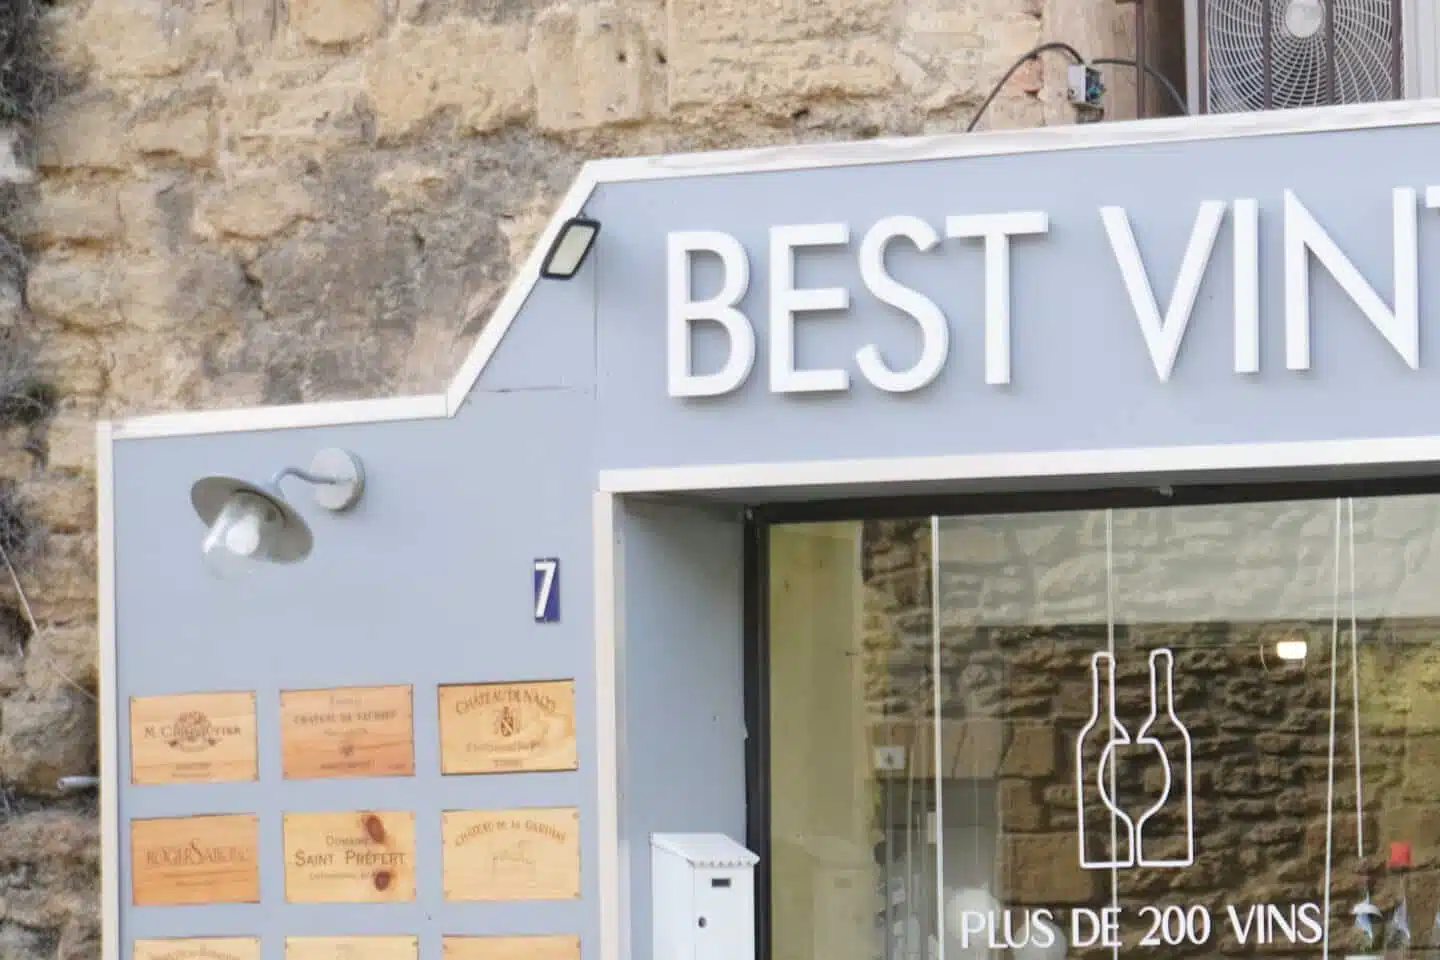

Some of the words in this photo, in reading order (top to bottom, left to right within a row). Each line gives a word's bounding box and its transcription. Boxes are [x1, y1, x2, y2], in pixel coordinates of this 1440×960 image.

[666, 211, 1049, 398] BEST
[535, 562, 557, 617] 7
[294, 850, 335, 866] SAINT
[960, 907, 1055, 949] PLUS
[1071, 906, 1122, 948] DE
[1138, 904, 1211, 946] 200
[1226, 902, 1324, 945] VINS
